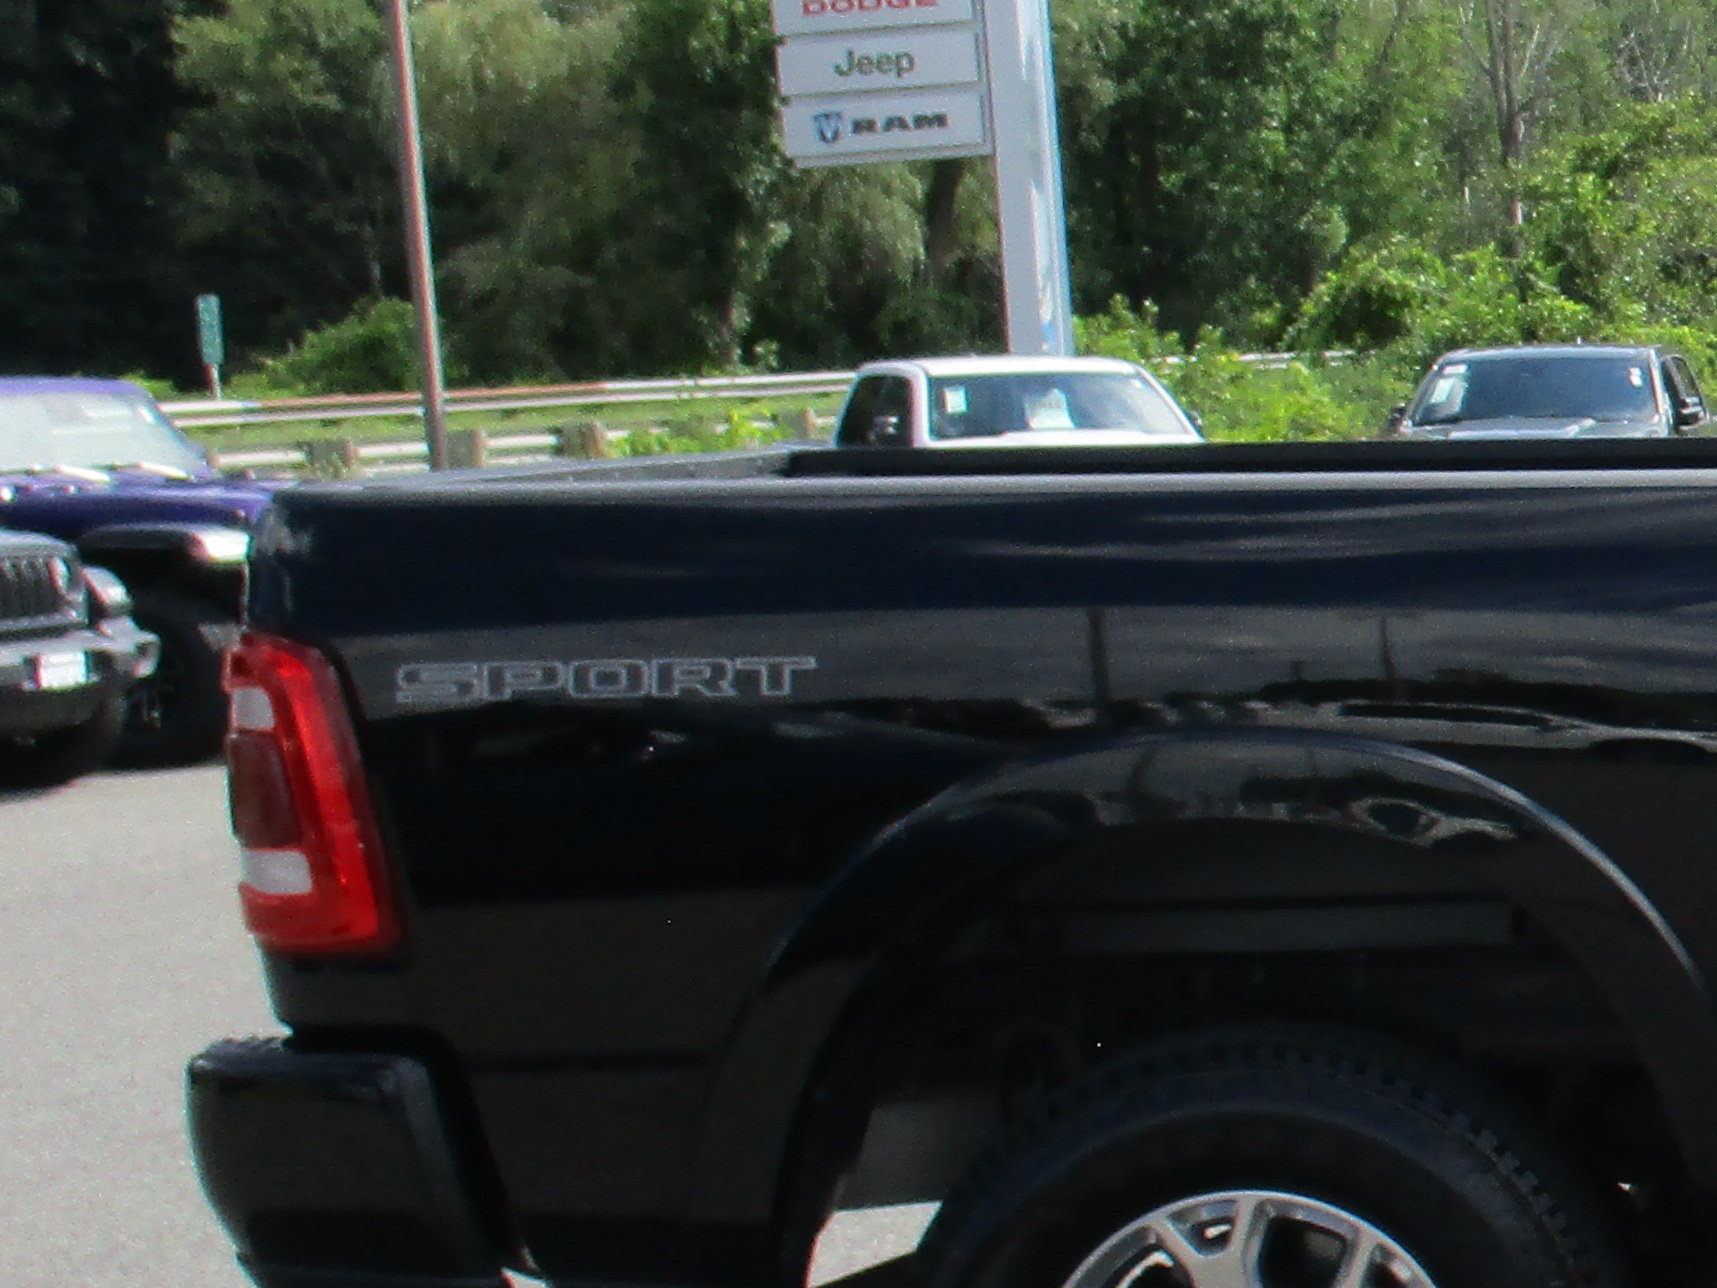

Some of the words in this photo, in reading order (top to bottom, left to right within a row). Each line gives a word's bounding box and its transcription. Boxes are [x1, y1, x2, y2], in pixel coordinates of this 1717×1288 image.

[834, 49, 916, 79] Jeep
[852, 113, 949, 134] RAM
[396, 656, 818, 703] SPORT
